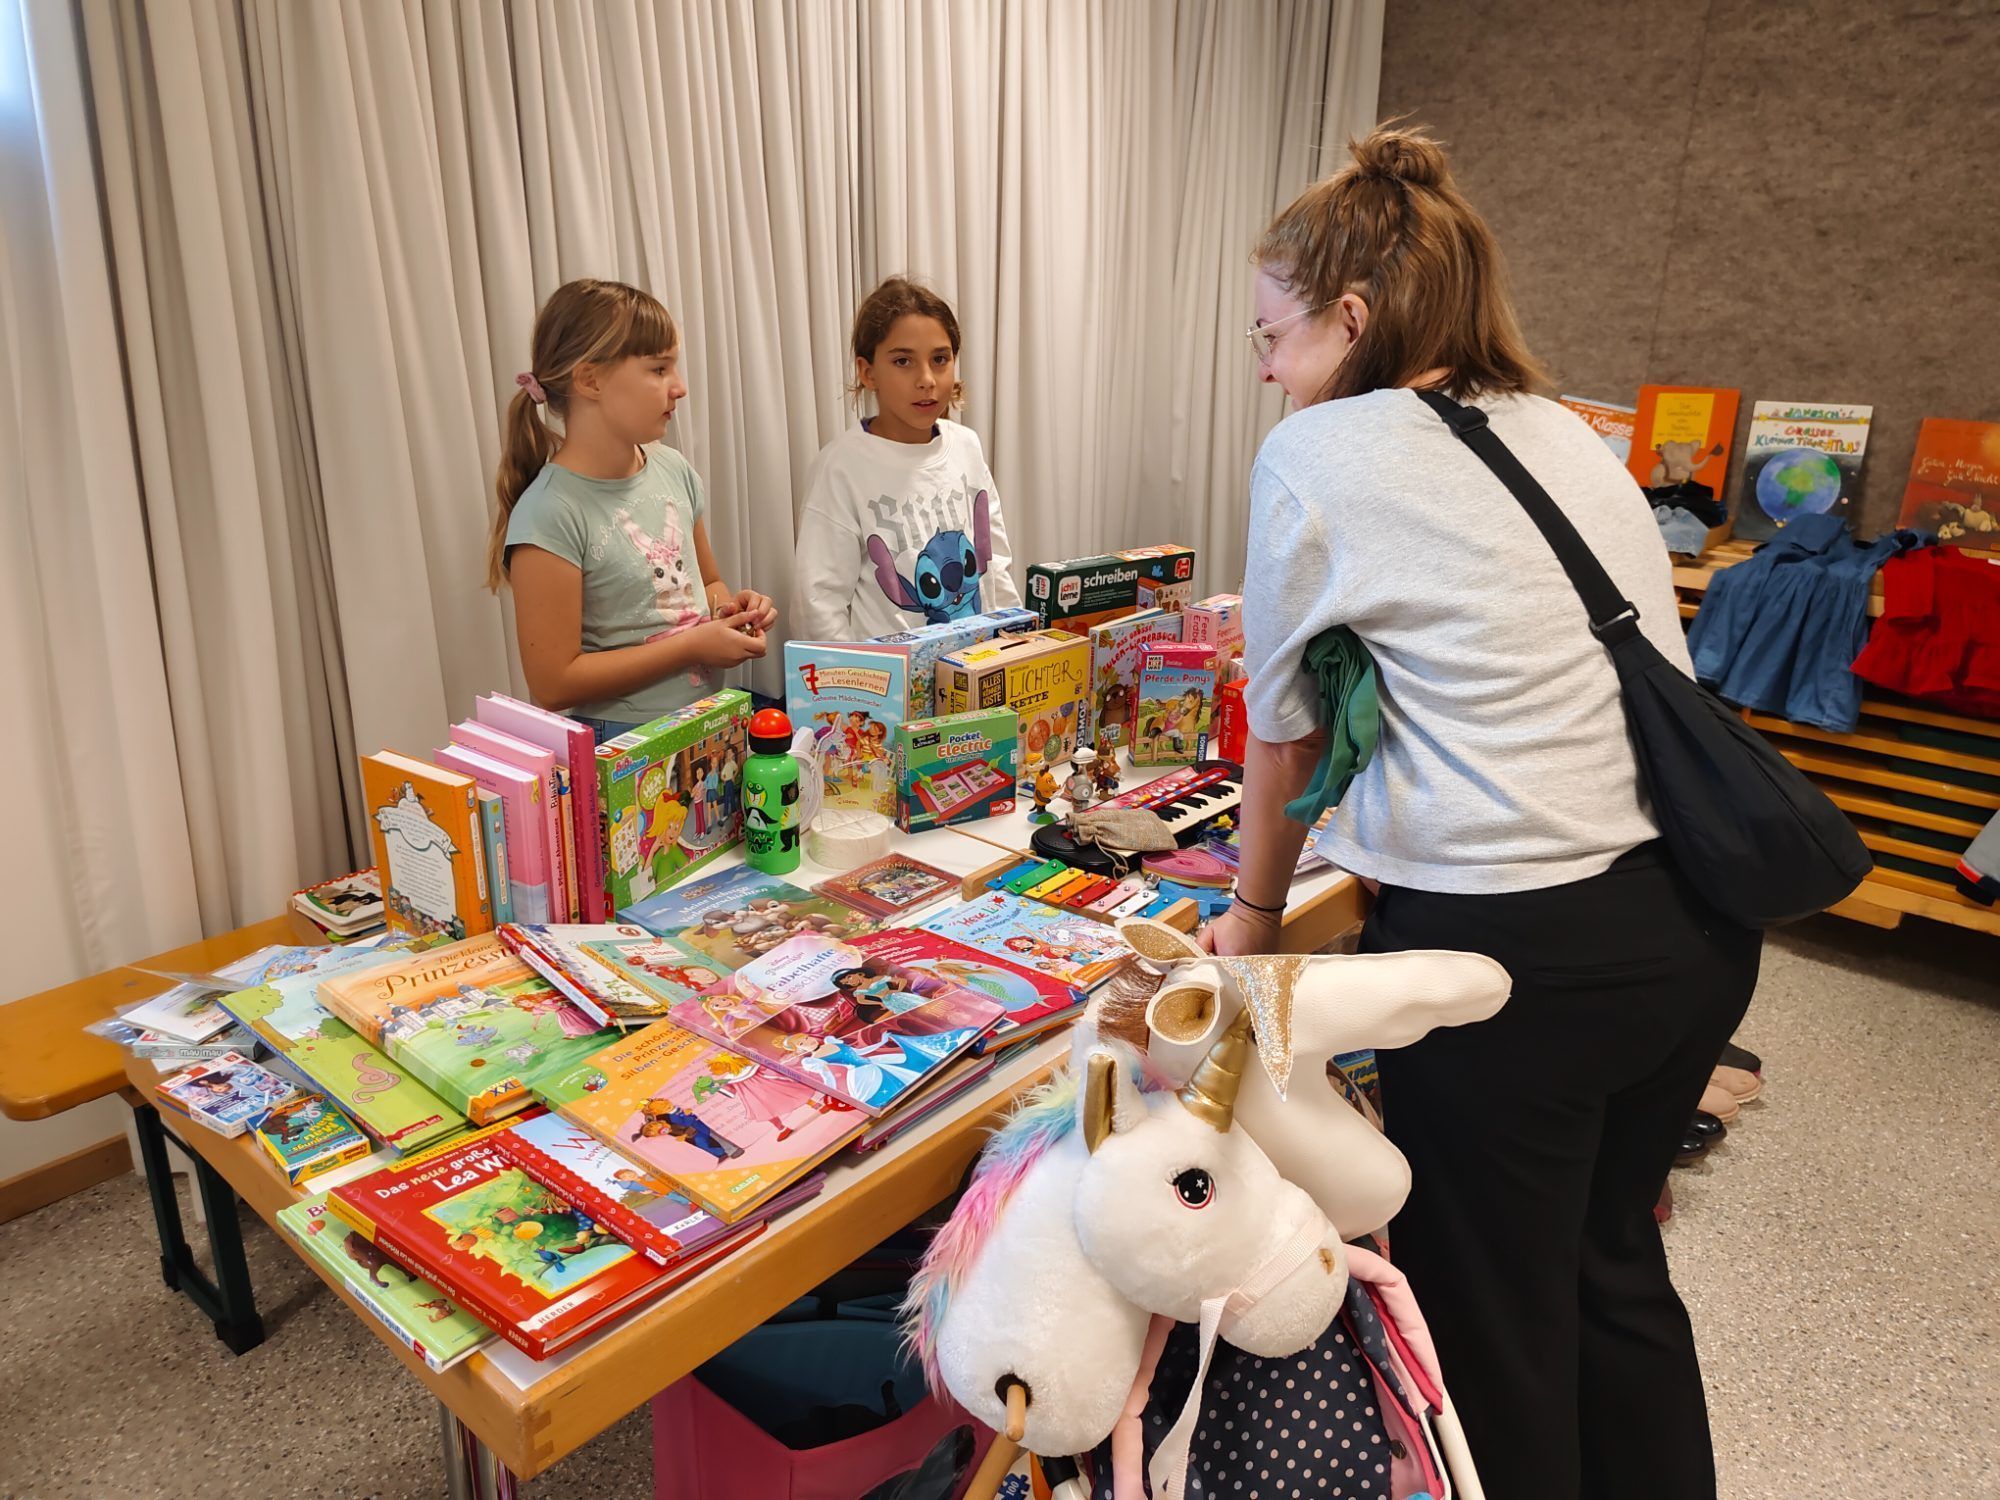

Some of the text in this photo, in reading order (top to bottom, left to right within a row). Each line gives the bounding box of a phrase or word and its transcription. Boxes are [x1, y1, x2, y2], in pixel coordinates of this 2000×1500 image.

[1083, 568, 1138, 589] schreiben
[1191, 614, 1201, 644] Erdbe
[799, 663, 819, 695] 7
[831, 676, 886, 693] Lesenlernen
[1144, 673, 1174, 683] Pferde
[1182, 673, 1210, 685] Ponys
[739, 701, 749, 716] 60
[703, 713, 729, 732] Puzzle
[1076, 700, 1088, 749] OSMOS
[949, 731, 981, 744] Pocket
[937, 739, 992, 758] Electric
[1198, 735, 1206, 762] KOSMOS
[766, 948, 838, 993] Fabelhafte
[612, 1049, 633, 1063] Die
[490, 1080, 520, 1097] XXL
[374, 1179, 409, 1199] Das
[410, 1165, 449, 1186] neue
[451, 1146, 494, 1171] große
[432, 1167, 480, 1194] Lea
[537, 1301, 576, 1325] HERDER
[1006, 1481, 1020, 1497] 100
